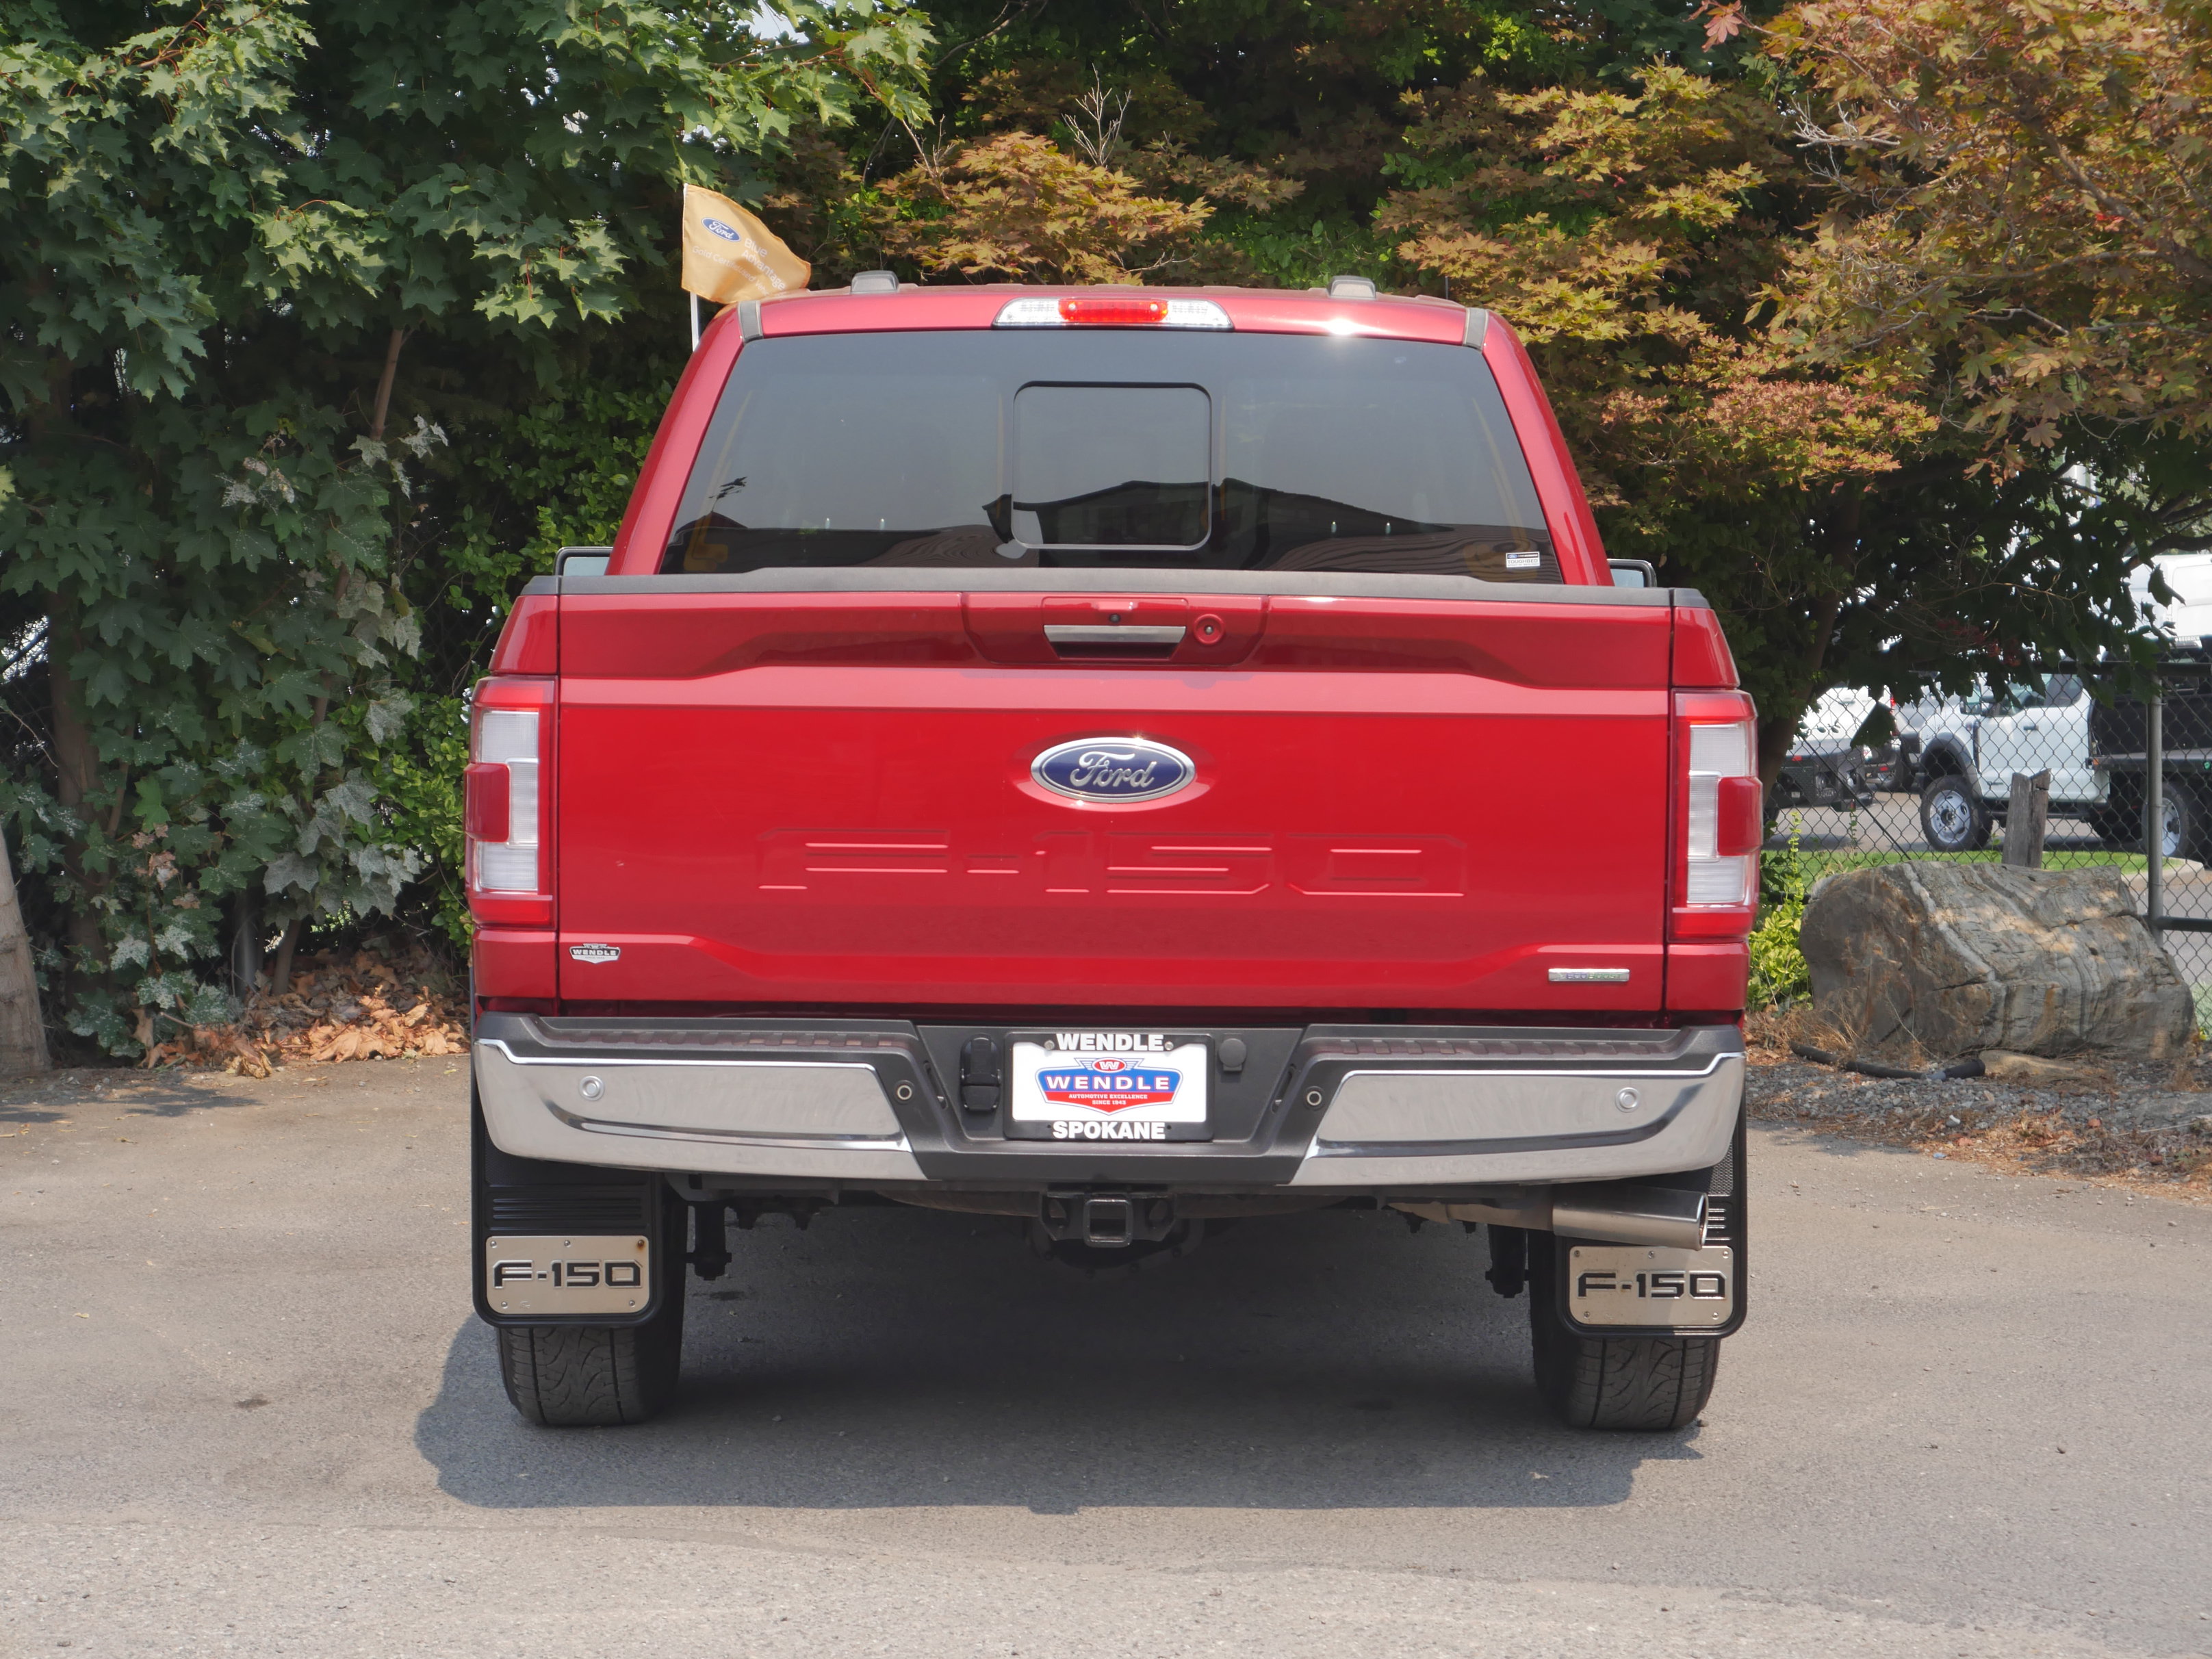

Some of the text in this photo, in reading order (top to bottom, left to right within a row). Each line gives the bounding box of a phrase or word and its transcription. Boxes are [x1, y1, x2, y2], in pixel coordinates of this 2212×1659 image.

[709, 221, 734, 239] Ford
[693, 246, 712, 258] Gold
[745, 238, 767, 257] Blue
[741, 250, 786, 290] Advantage
[1070, 751, 1157, 788] Ford
[756, 827, 1466, 898] F-150
[1056, 1033, 1163, 1051] WENDLE
[1045, 1076, 1170, 1090] WENDLE
[1053, 1121, 1166, 1140] SPOKANE
[493, 1259, 643, 1288] F-150
[1576, 1271, 1727, 1300] F-150
